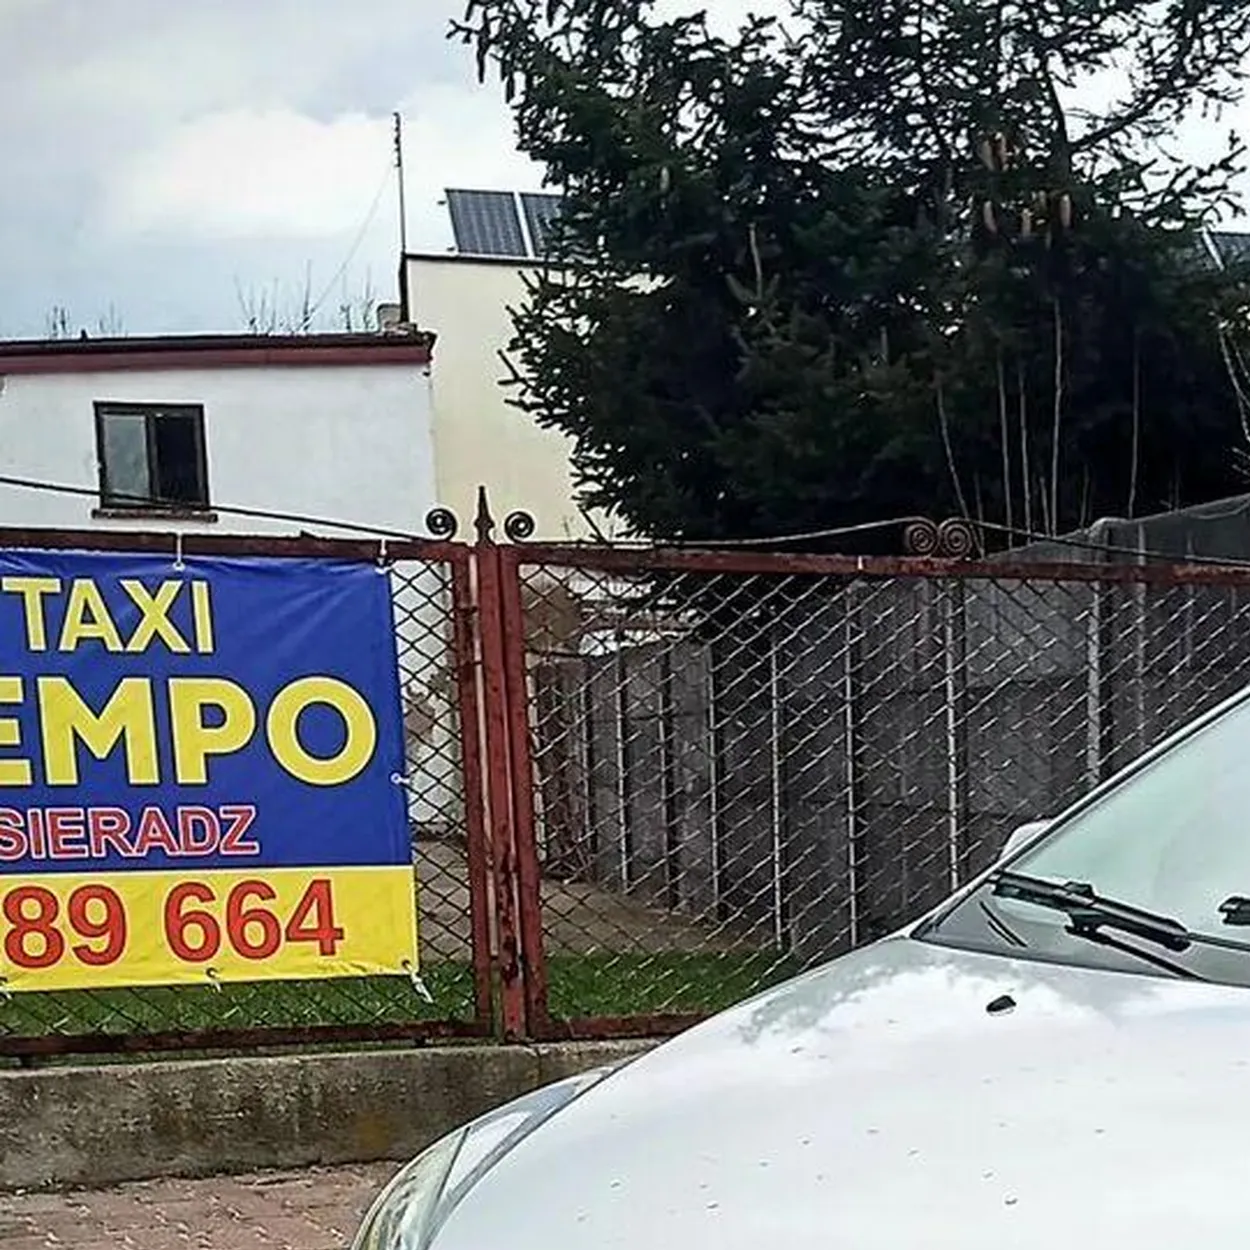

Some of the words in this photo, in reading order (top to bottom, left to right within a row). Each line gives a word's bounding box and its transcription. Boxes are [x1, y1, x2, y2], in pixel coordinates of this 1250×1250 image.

[2, 577, 214, 653] TAXI
[0, 805, 259, 860] SIERADZ
[3, 883, 127, 968] 89
[164, 879, 344, 962] 664
